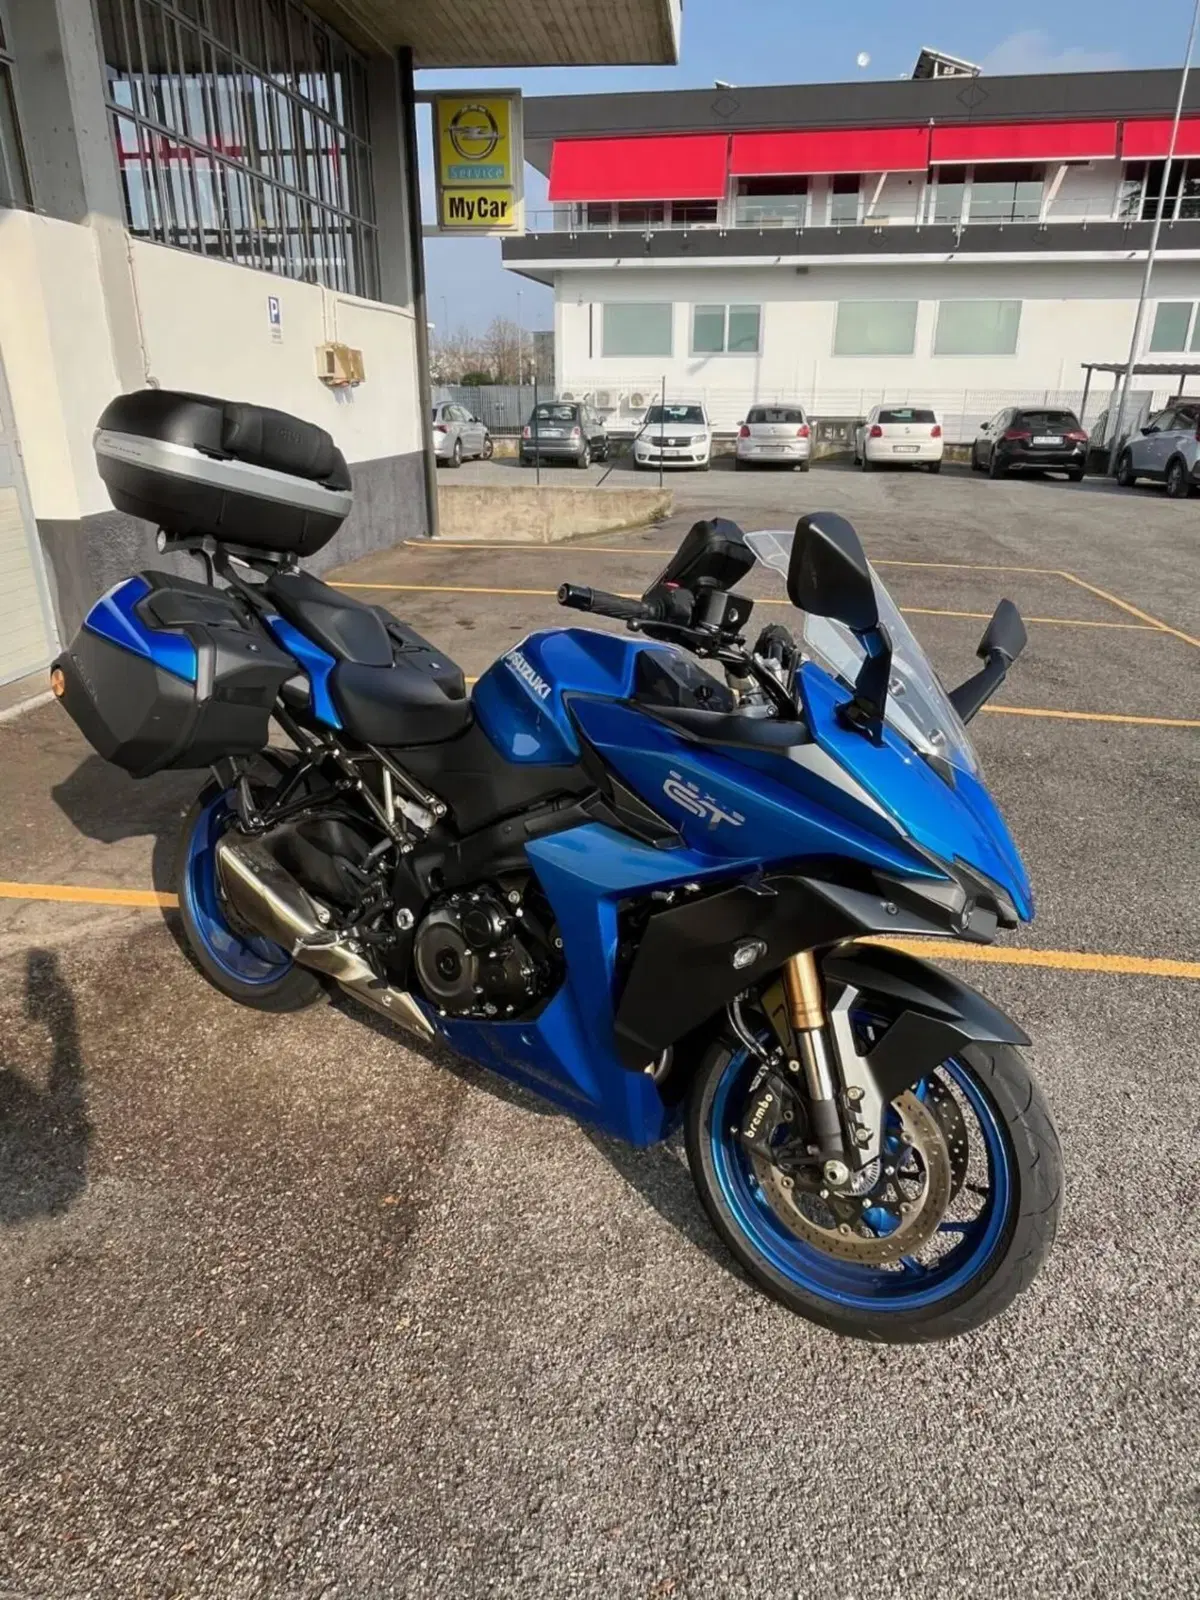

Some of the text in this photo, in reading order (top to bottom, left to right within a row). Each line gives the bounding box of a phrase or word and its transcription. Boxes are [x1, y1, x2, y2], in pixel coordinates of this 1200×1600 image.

[450, 165, 503, 179] Service
[449, 197, 507, 220] MyCar
[269, 298, 279, 323] P
[511, 652, 551, 699] SUZUKI
[744, 1094, 773, 1138] brembo
